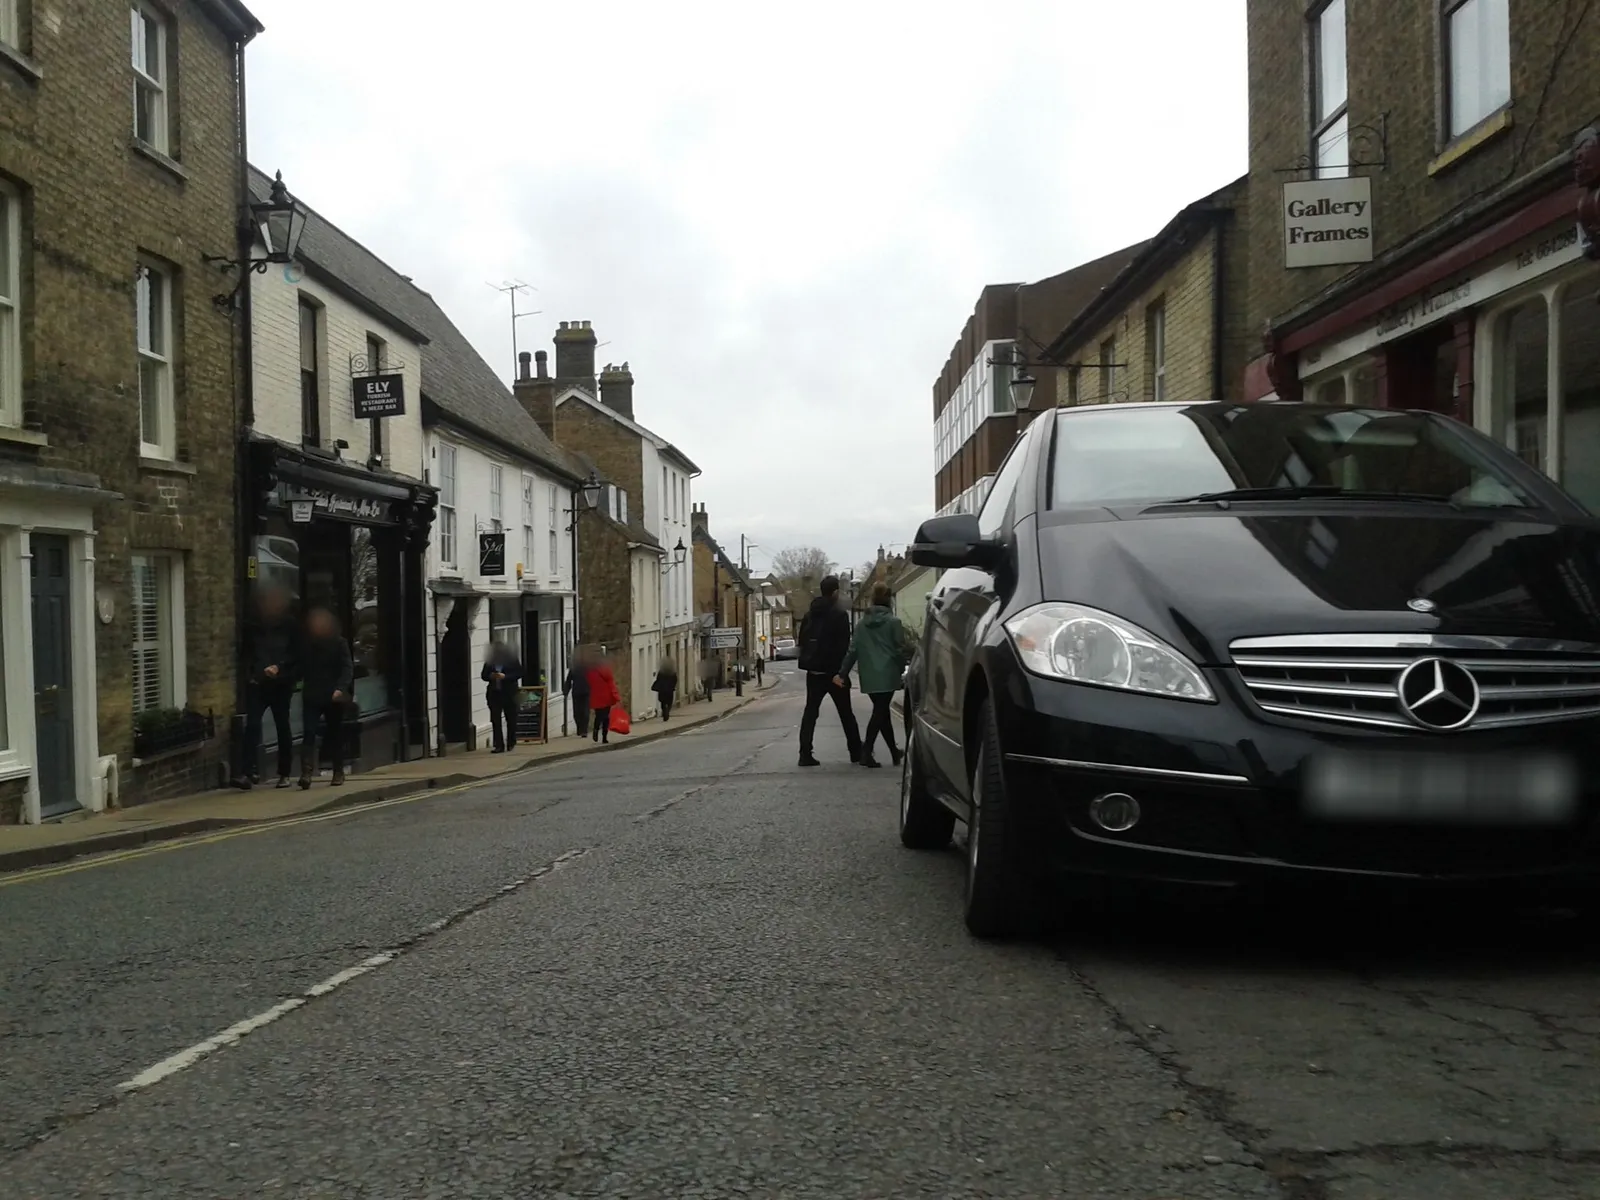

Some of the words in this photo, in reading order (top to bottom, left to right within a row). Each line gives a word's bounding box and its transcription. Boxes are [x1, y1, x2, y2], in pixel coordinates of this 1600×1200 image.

[1287, 198, 1368, 218] Gallery
[1288, 226, 1370, 245] Frames
[366, 381, 390, 394] ELY
[361, 398, 397, 406] RESTAURANT
